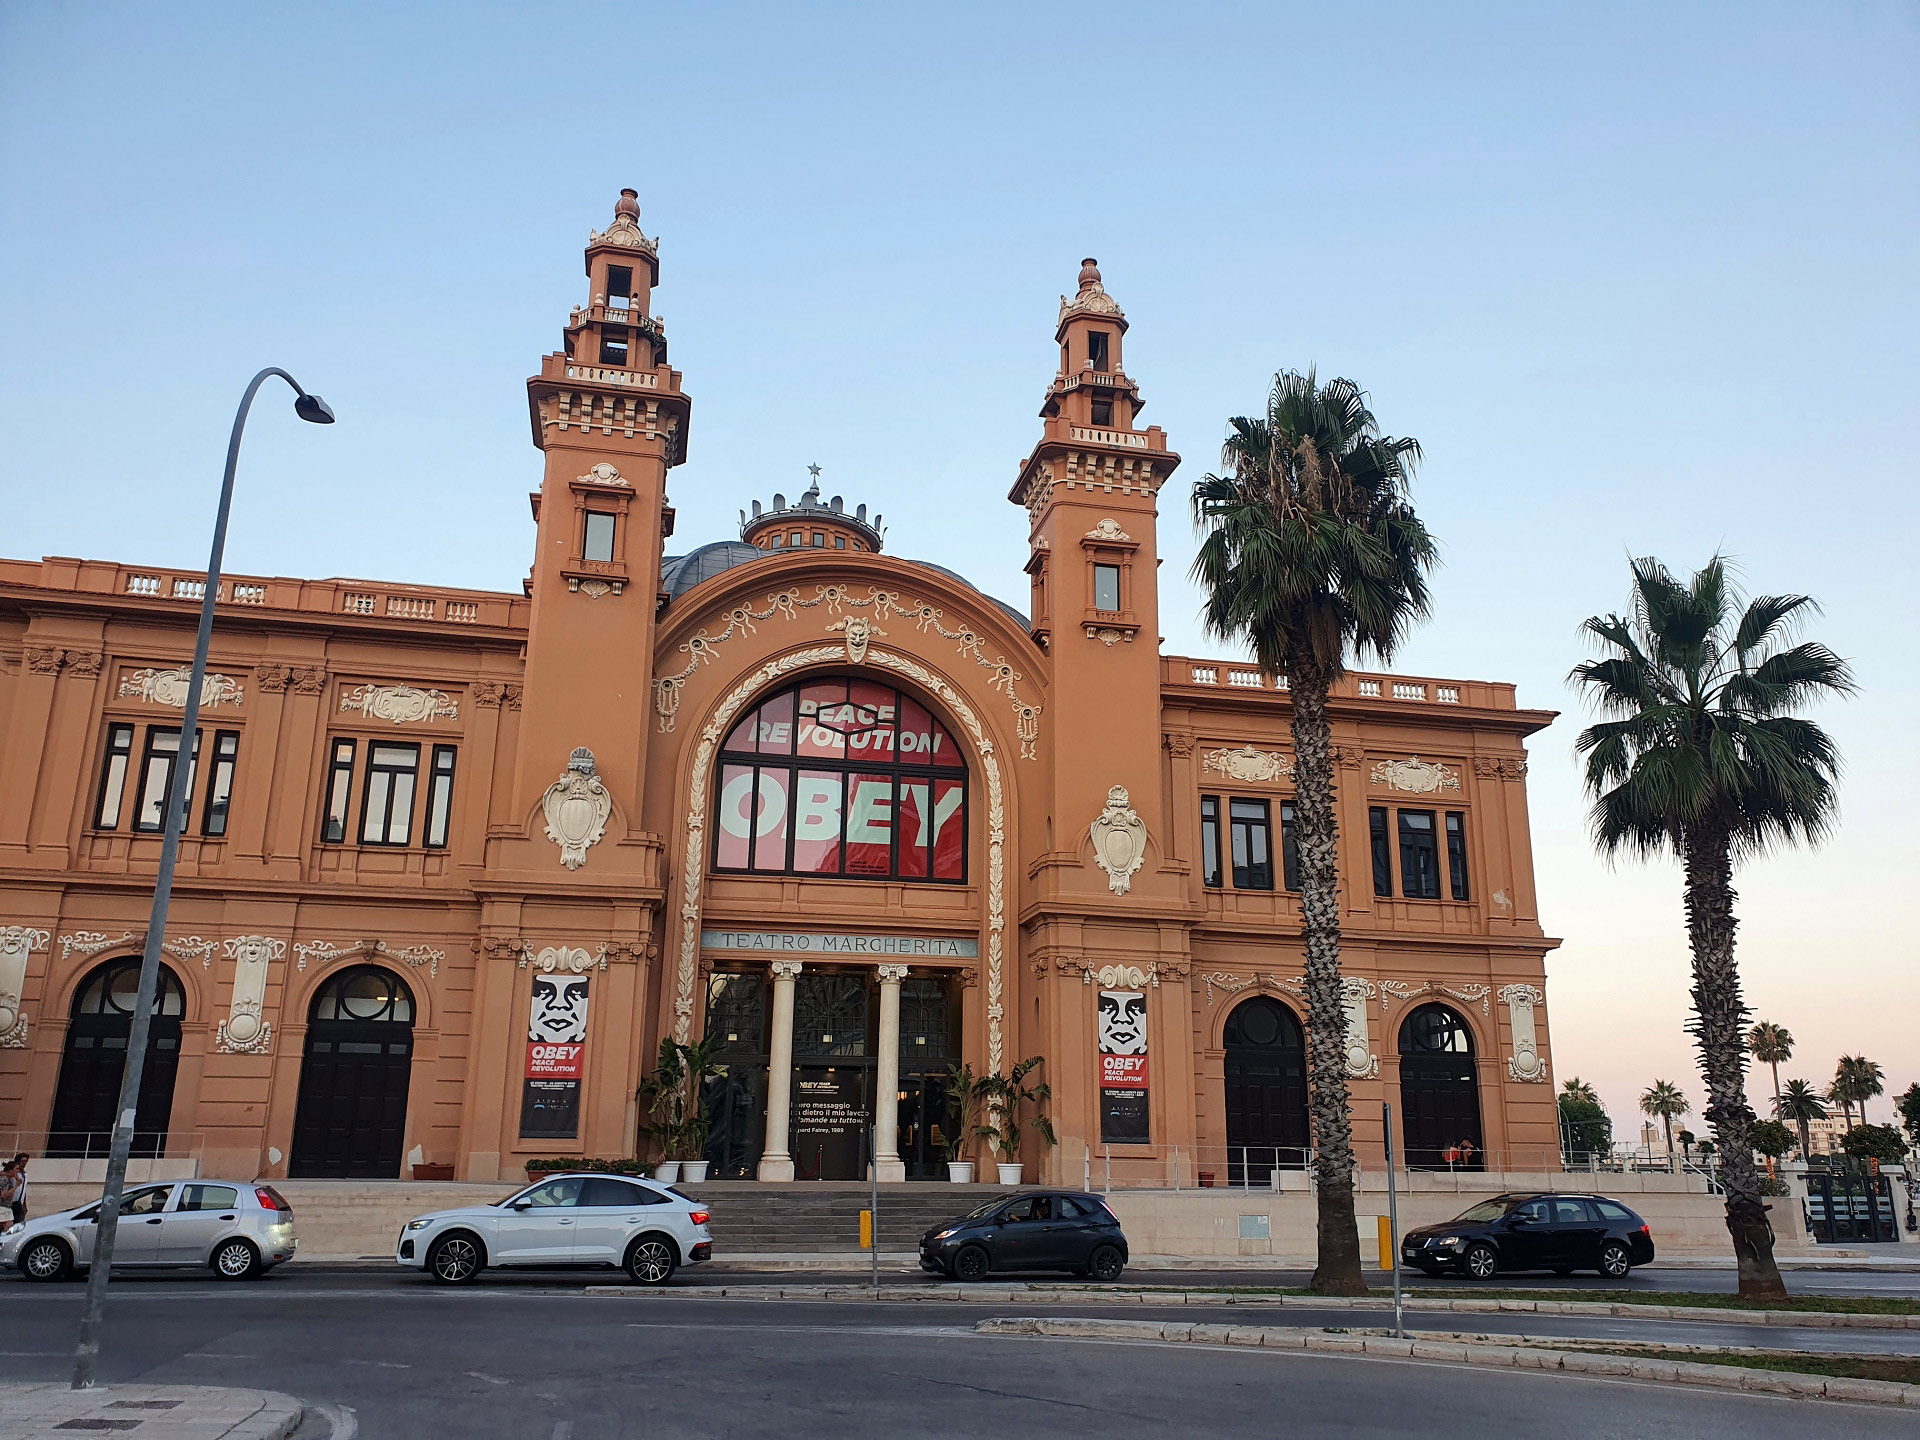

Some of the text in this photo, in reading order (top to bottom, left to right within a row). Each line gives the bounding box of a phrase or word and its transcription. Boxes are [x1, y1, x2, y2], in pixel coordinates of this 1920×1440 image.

[799, 700, 895, 725] PEACE
[748, 721, 942, 754] REVOLUTION
[720, 773, 963, 848] OBEY
[722, 933, 959, 954] TEATRO MARGHERITA
[532, 1046, 581, 1059] OBEY
[1104, 1057, 1144, 1070] OBEY
[812, 1102, 851, 1110] messaggio
